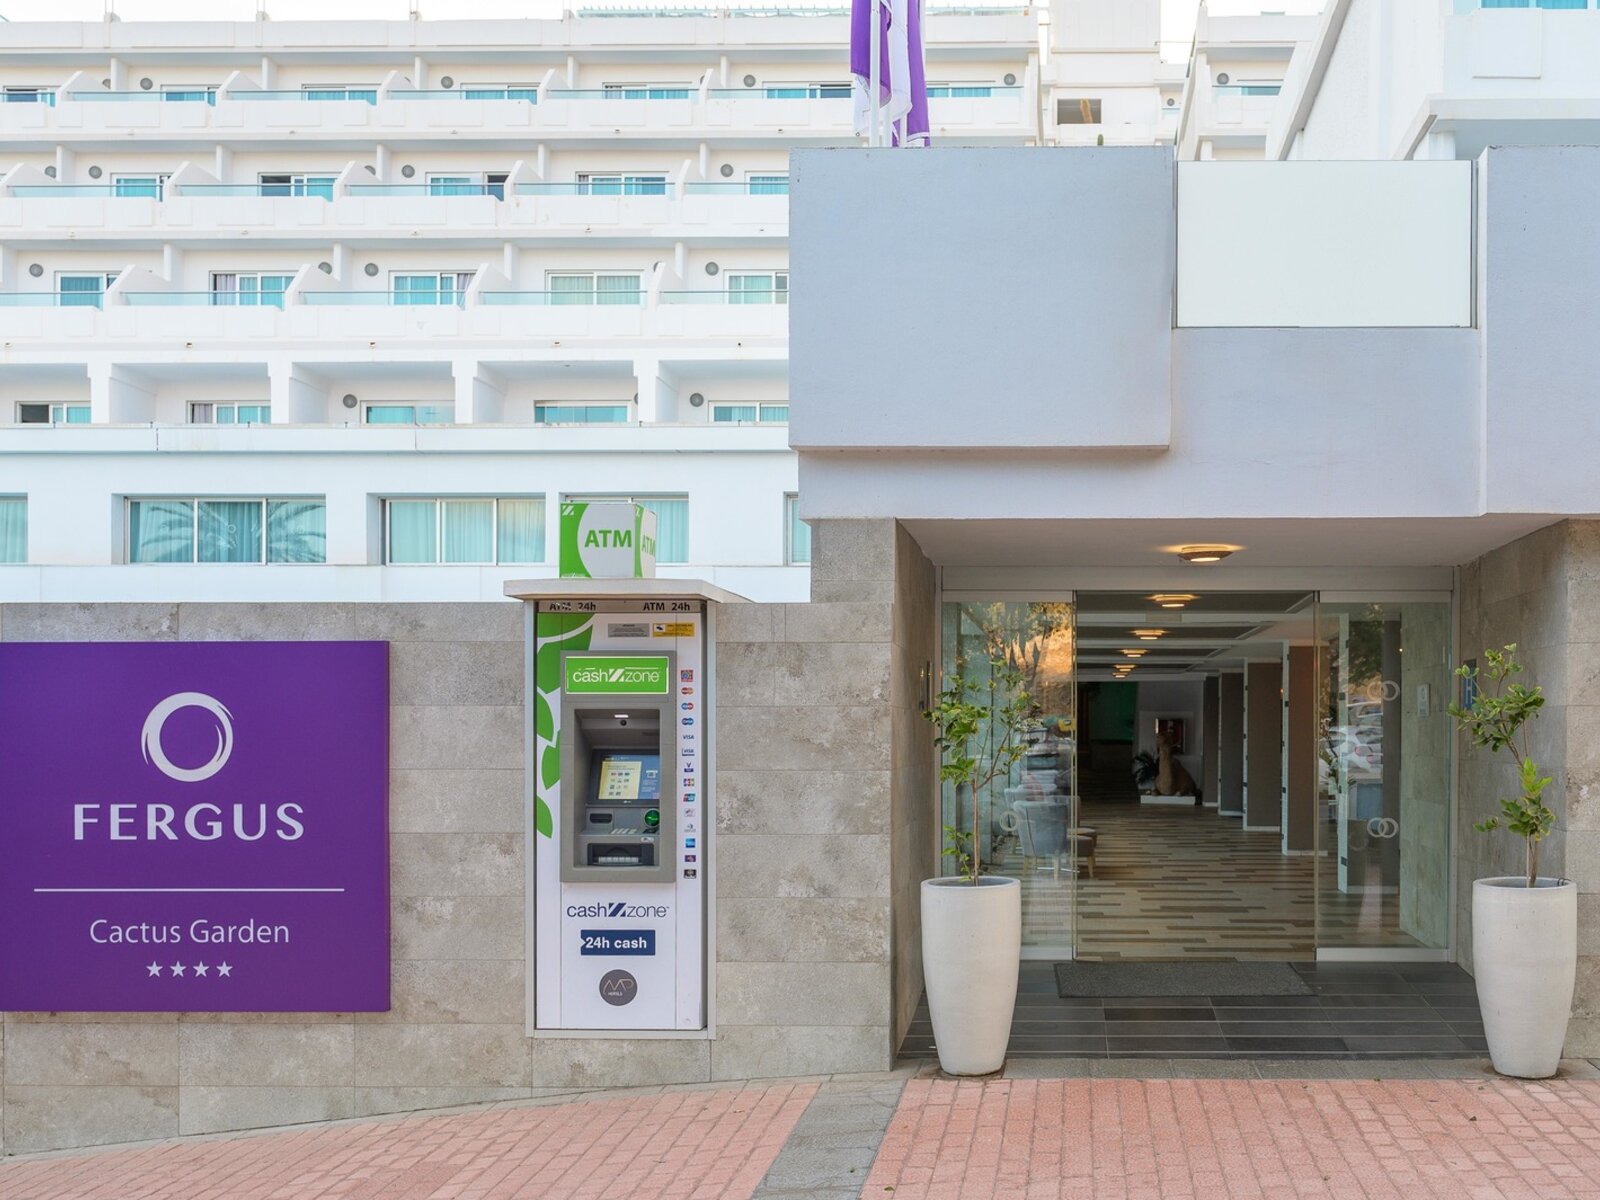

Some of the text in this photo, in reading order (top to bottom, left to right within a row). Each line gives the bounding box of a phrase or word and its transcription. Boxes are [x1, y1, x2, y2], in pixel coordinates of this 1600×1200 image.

[584, 529, 632, 548] ATM
[641, 534, 656, 557] ATM
[577, 602, 596, 611] 24h
[643, 602, 690, 611] ATM 24h
[74, 803, 304, 841] FERGUS
[89, 918, 290, 944] Cactus Garden
[585, 936, 647, 949] 24h cash
